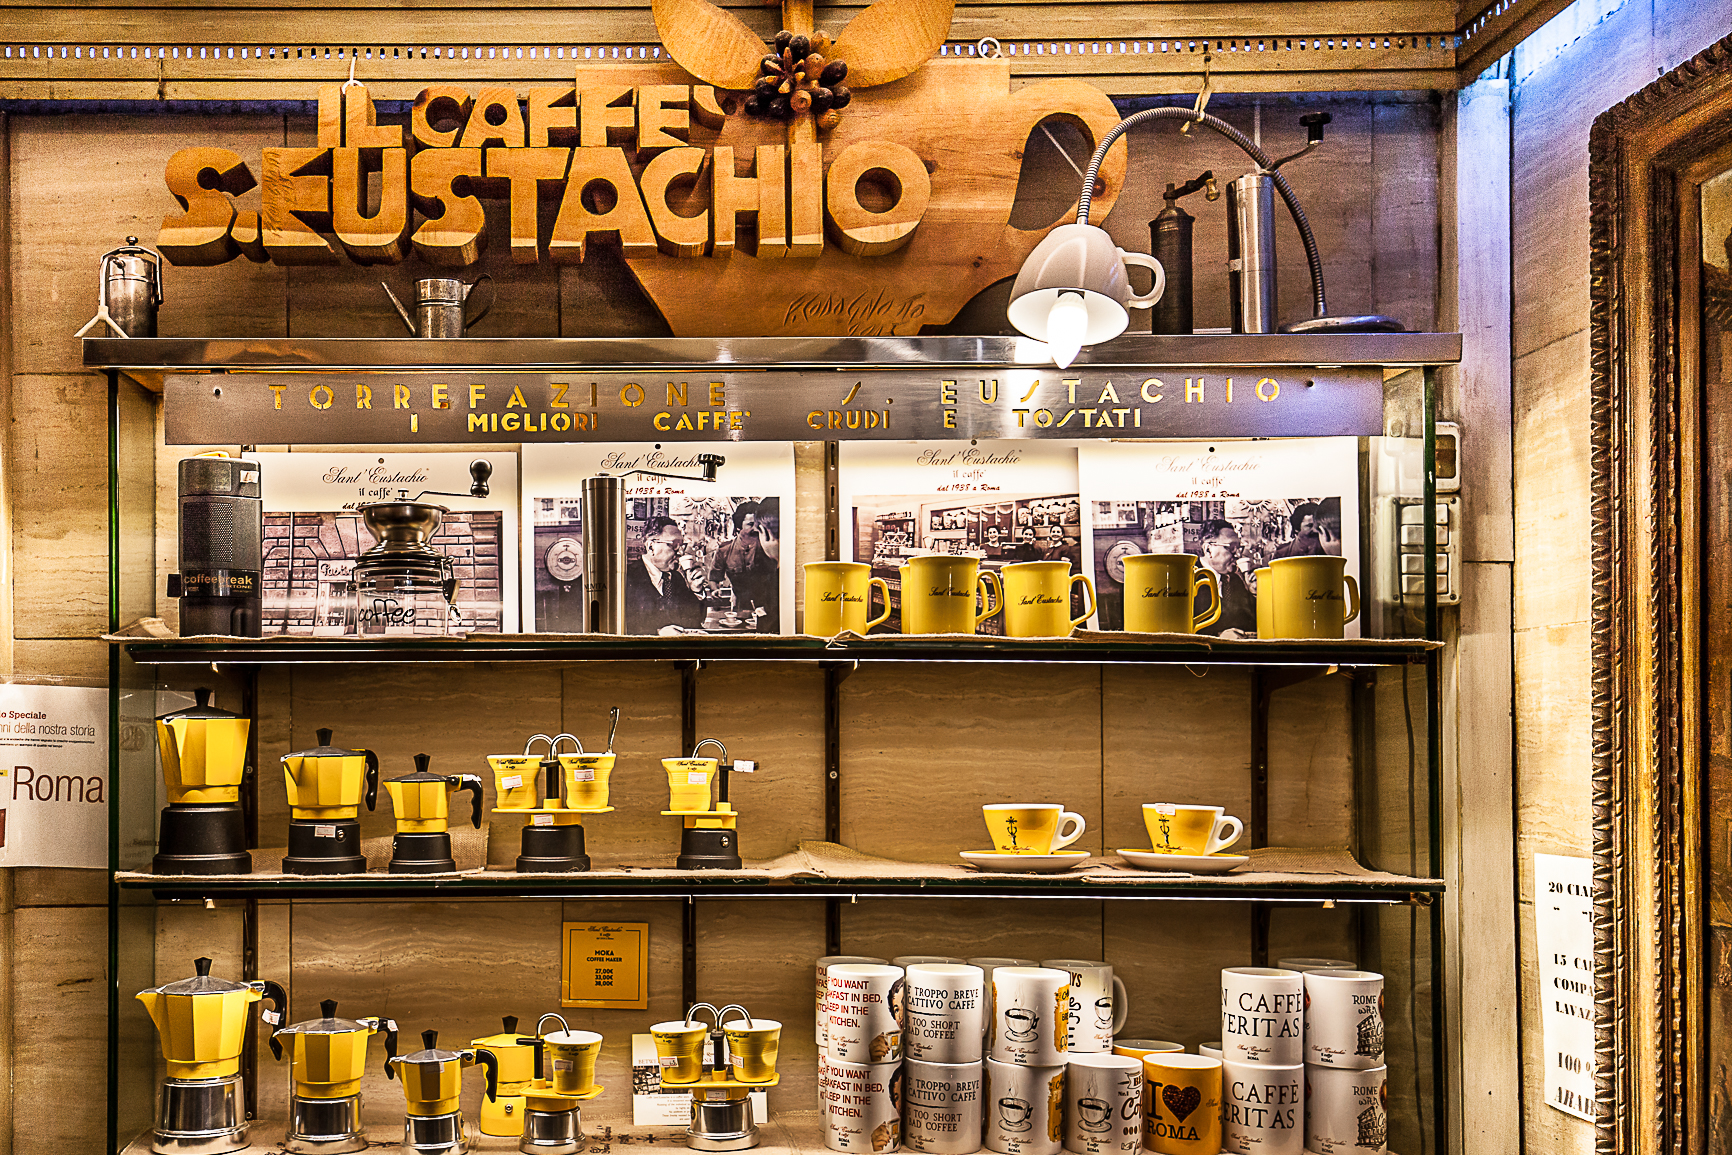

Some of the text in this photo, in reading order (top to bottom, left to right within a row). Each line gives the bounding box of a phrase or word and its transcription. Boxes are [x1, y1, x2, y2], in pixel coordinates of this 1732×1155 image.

[318, 84, 404, 148] IL
[268, 381, 727, 410] TORREFAZIONE
[940, 377, 1281, 406] EUSTACHIO
[410, 412, 420, 434] I
[467, 411, 599, 434] MIGLIORI
[806, 409, 891, 431] CRUDI
[943, 408, 958, 429] E
[1012, 407, 1141, 429] TOSTATI
[664, 487, 685, 495] Roma
[980, 483, 1001, 491] Roma
[1219, 490, 1240, 498] Roma
[359, 599, 416, 625] coffee
[9, 710, 47, 720] Speciale
[14, 722, 36, 735] della
[39, 723, 67, 736] nostra
[70, 724, 96, 737] storia
[13, 765, 105, 804] Roma
[1548, 881, 1564, 894] 20
[594, 949, 615, 957] MOKA
[1553, 953, 1567, 966] 15
[844, 979, 870, 990] WANT
[851, 993, 860, 1003] IN
[863, 993, 883, 1004] BED,
[914, 986, 949, 1000] TROPPO
[954, 988, 979, 1000] BREVE
[1352, 994, 1377, 1005] ROME
[907, 995, 944, 1010] CATTIVO
[1238, 987, 1303, 1014] CAFFÈ
[841, 1005, 849, 1015] IN
[851, 1005, 869, 1016] THE
[912, 1016, 927, 1028] TOO
[930, 1019, 961, 1030] SHORT
[923, 1029, 955, 1040] COFFEE
[1558, 1051, 1581, 1075] 100
[830, 1066, 844, 1078] YOU
[845, 1069, 872, 1080] WANT
[853, 1082, 863, 1093] IN
[864, 1083, 885, 1094] BED,
[915, 1078, 951, 1092] TROPPO
[956, 1079, 980, 1092] BREVE
[1231, 1079, 1299, 1105] CAFFÈ
[1352, 1085, 1379, 1096] ROME
[842, 1094, 852, 1105] IN
[853, 1095, 872, 1106] THE
[908, 1087, 946, 1102] CATTIVO
[1146, 1078, 1164, 1121] I
[828, 1103, 863, 1118] KITCHEN.
[913, 1108, 929, 1121] TOO
[933, 1112, 963, 1123] SHORT
[925, 1121, 958, 1132] COFFEE
[1146, 1118, 1202, 1141] ROMA
